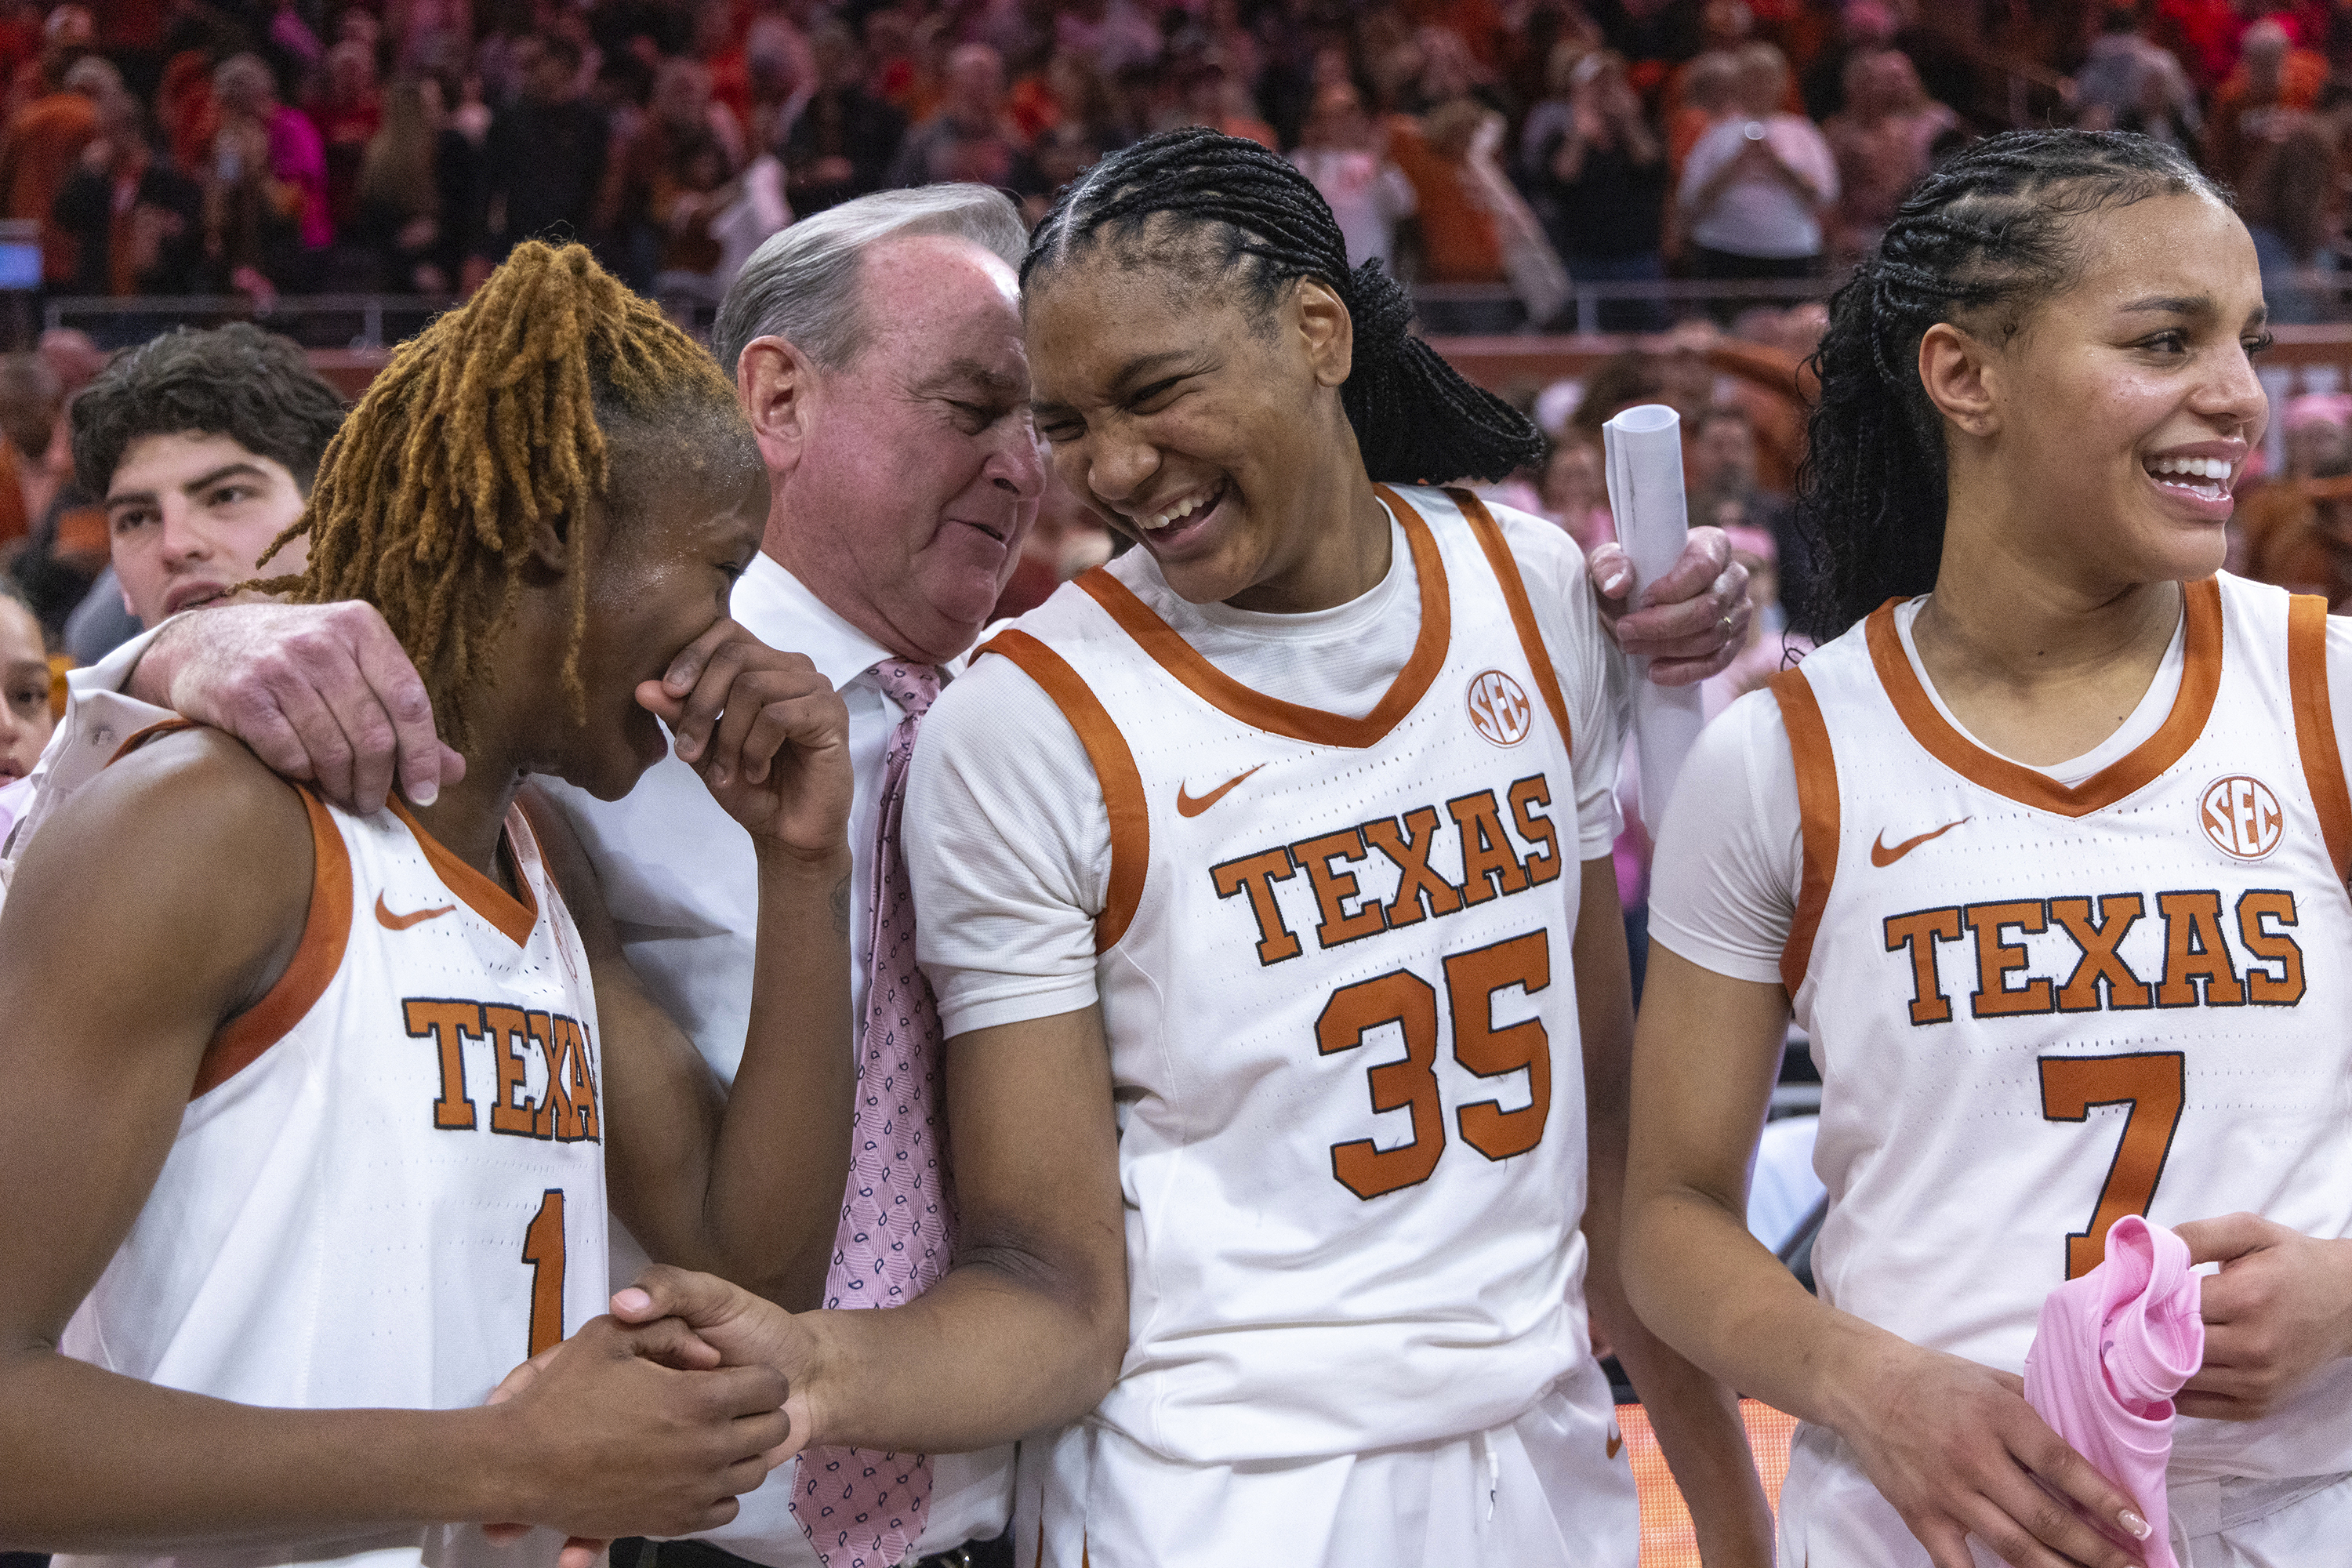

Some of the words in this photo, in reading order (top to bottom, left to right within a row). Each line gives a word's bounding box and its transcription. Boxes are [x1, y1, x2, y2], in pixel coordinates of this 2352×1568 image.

[1469, 672, 1530, 743] SEC
[1209, 772, 1562, 967] TEXAS
[2205, 779, 2279, 854] SEC
[1882, 889, 2307, 1025] TEXAS
[401, 997, 601, 1146] TEXA
[1314, 927, 1552, 1200] 35
[2038, 1051, 2185, 1280] 7
[521, 1188, 566, 1359] 1
